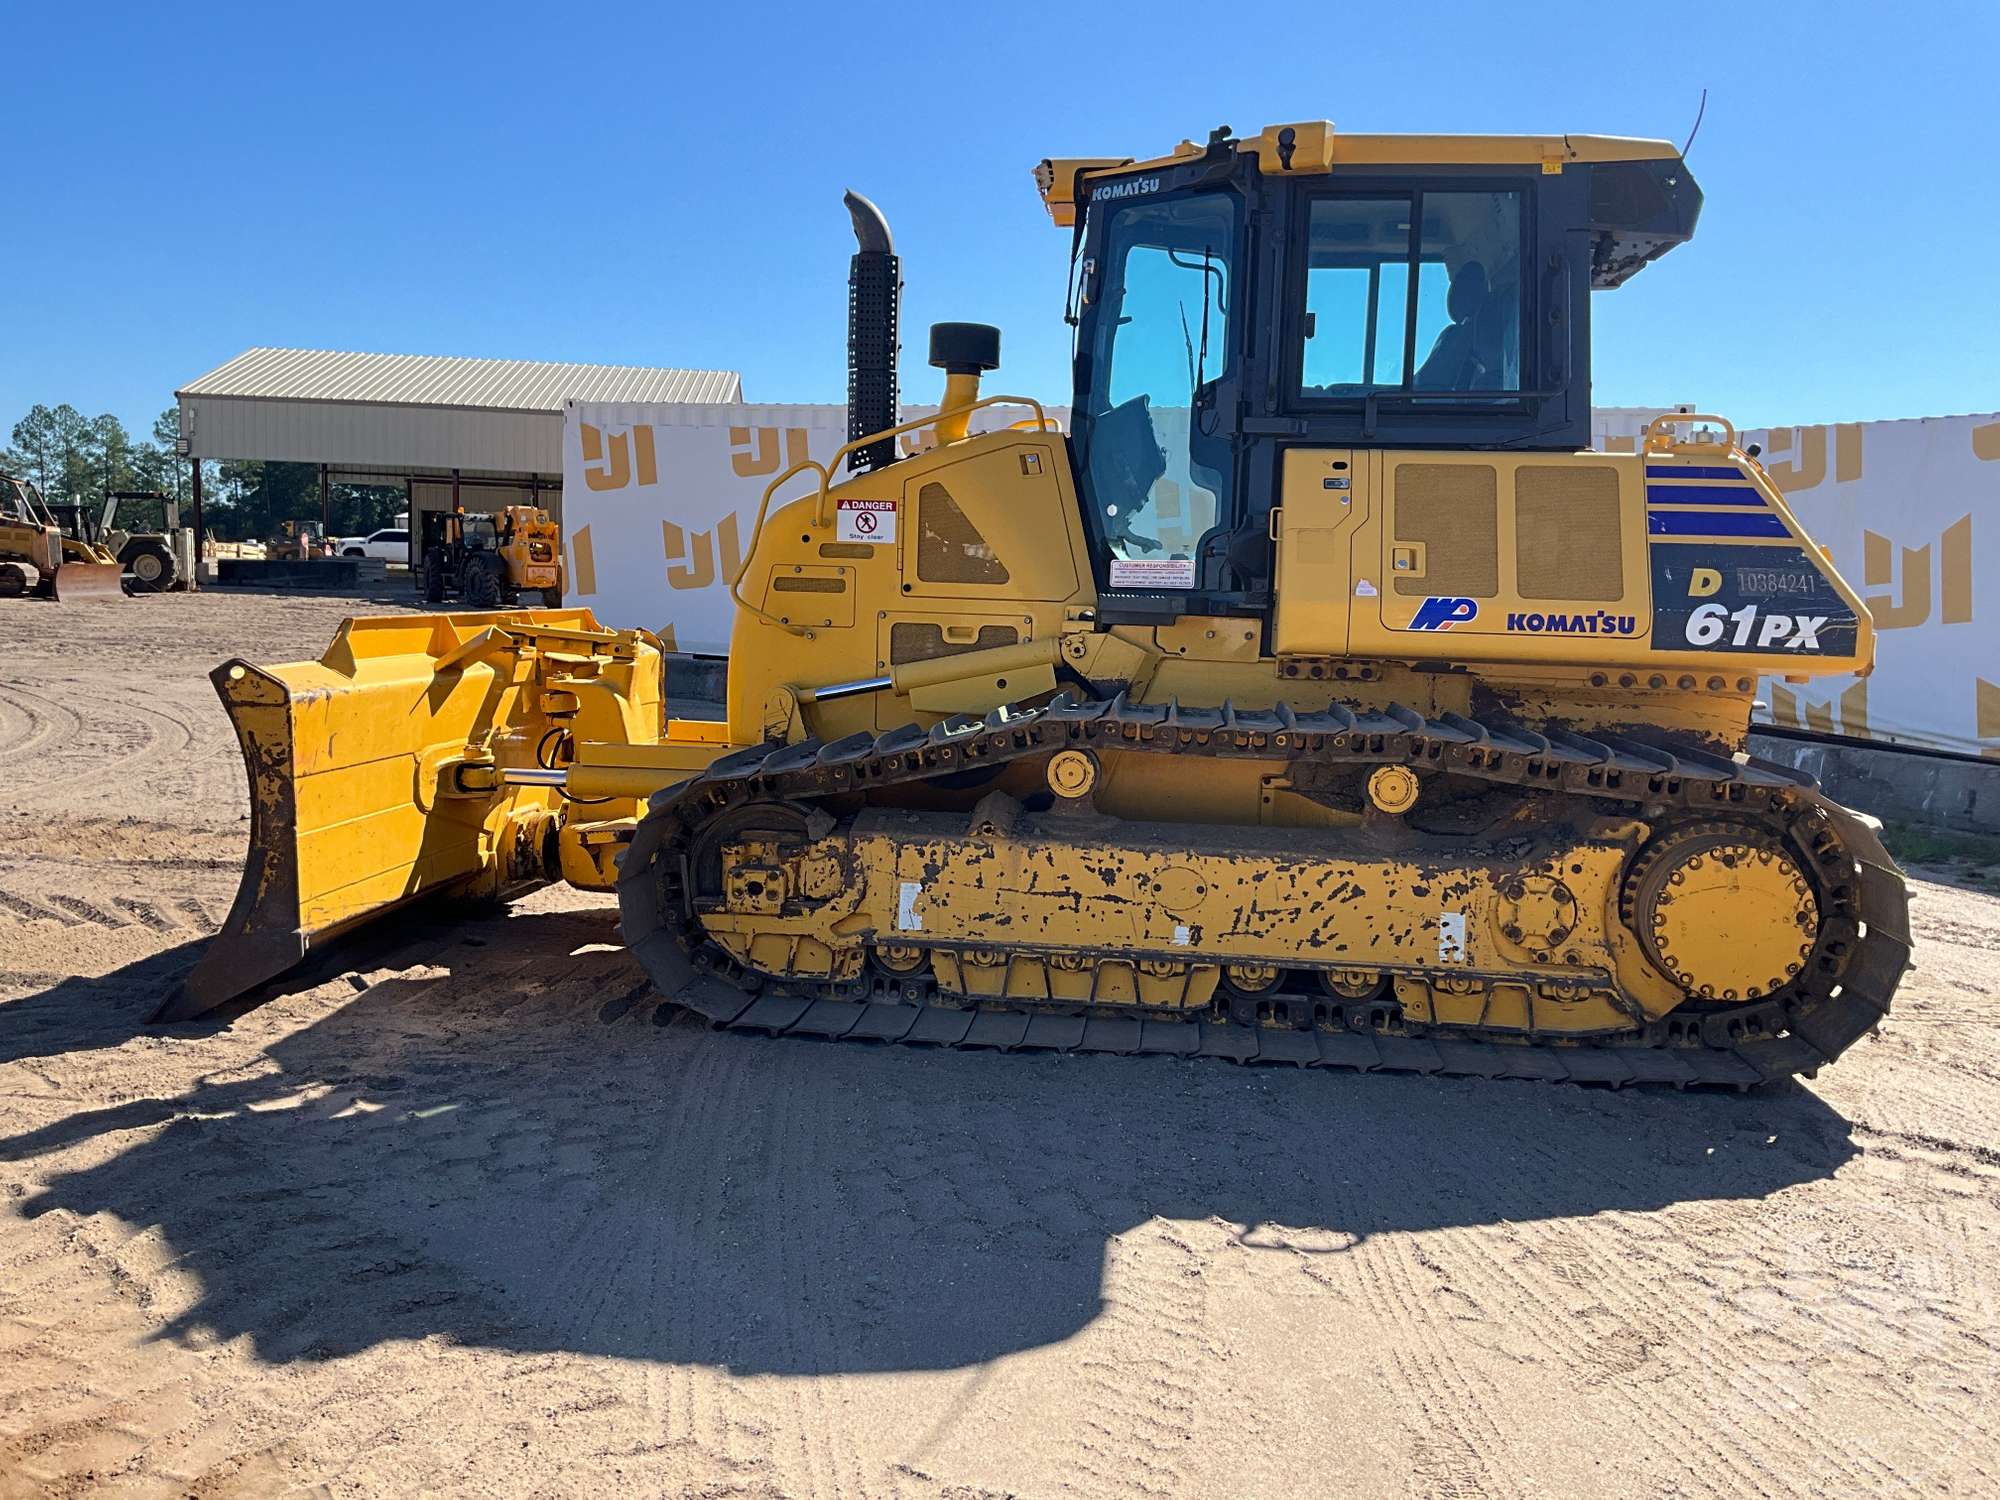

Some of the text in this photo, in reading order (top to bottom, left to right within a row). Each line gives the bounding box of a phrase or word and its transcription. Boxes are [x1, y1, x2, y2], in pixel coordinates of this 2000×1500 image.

[1092, 177, 1160, 201] KOMATSU
[852, 501, 893, 511] DANGER
[1688, 567, 1815, 597] D 10384241
[1507, 610, 1636, 635] KOMATSU
